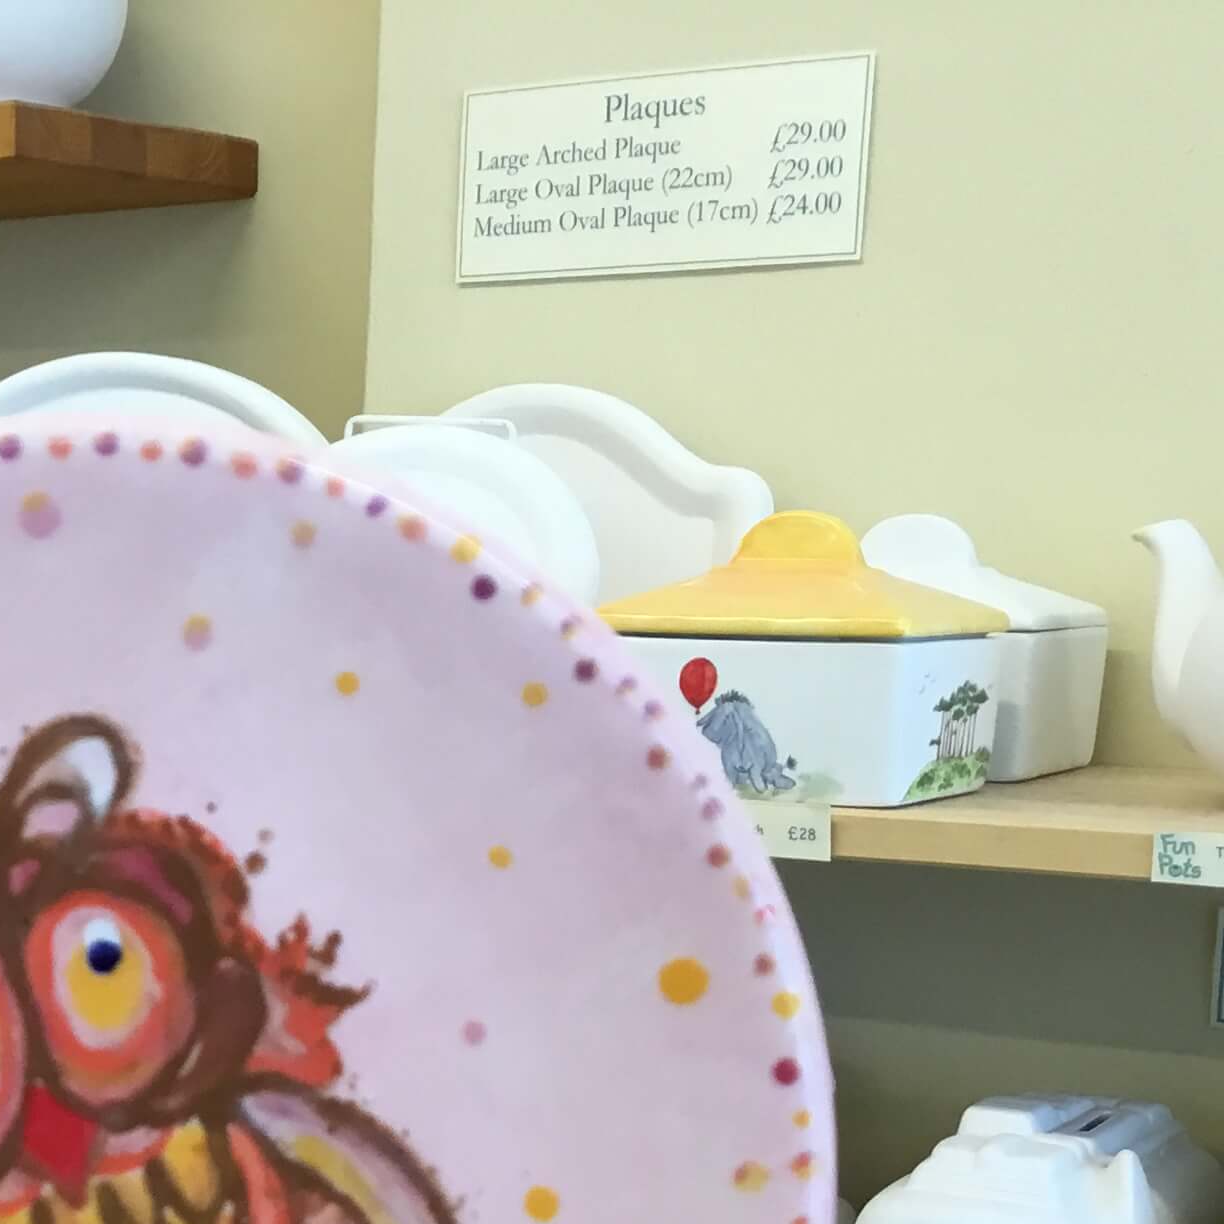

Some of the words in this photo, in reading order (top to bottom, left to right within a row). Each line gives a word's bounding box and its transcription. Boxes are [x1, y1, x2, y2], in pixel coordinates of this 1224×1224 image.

[605, 93, 706, 128] Plaques
[477, 151, 529, 176] Large
[536, 138, 607, 166] Arched
[614, 136, 681, 163] Plaque
[770, 119, 846, 153] £29.00
[476, 184, 528, 209] Large
[535, 176, 580, 200] Oval
[588, 173, 654, 200] Plaque
[662, 165, 732, 197] (22cm)
[767, 156, 843, 189] £29.00
[473, 214, 552, 238] Medium
[559, 208, 605, 232] Oval
[613, 205, 679, 232] Plaque
[687, 197, 758, 228] (17cm)
[766, 192, 842, 224] £24.00
[788, 825, 816, 841] £28
[1160, 834, 1196, 856] Fun
[1158, 852, 1201, 879] Pots
